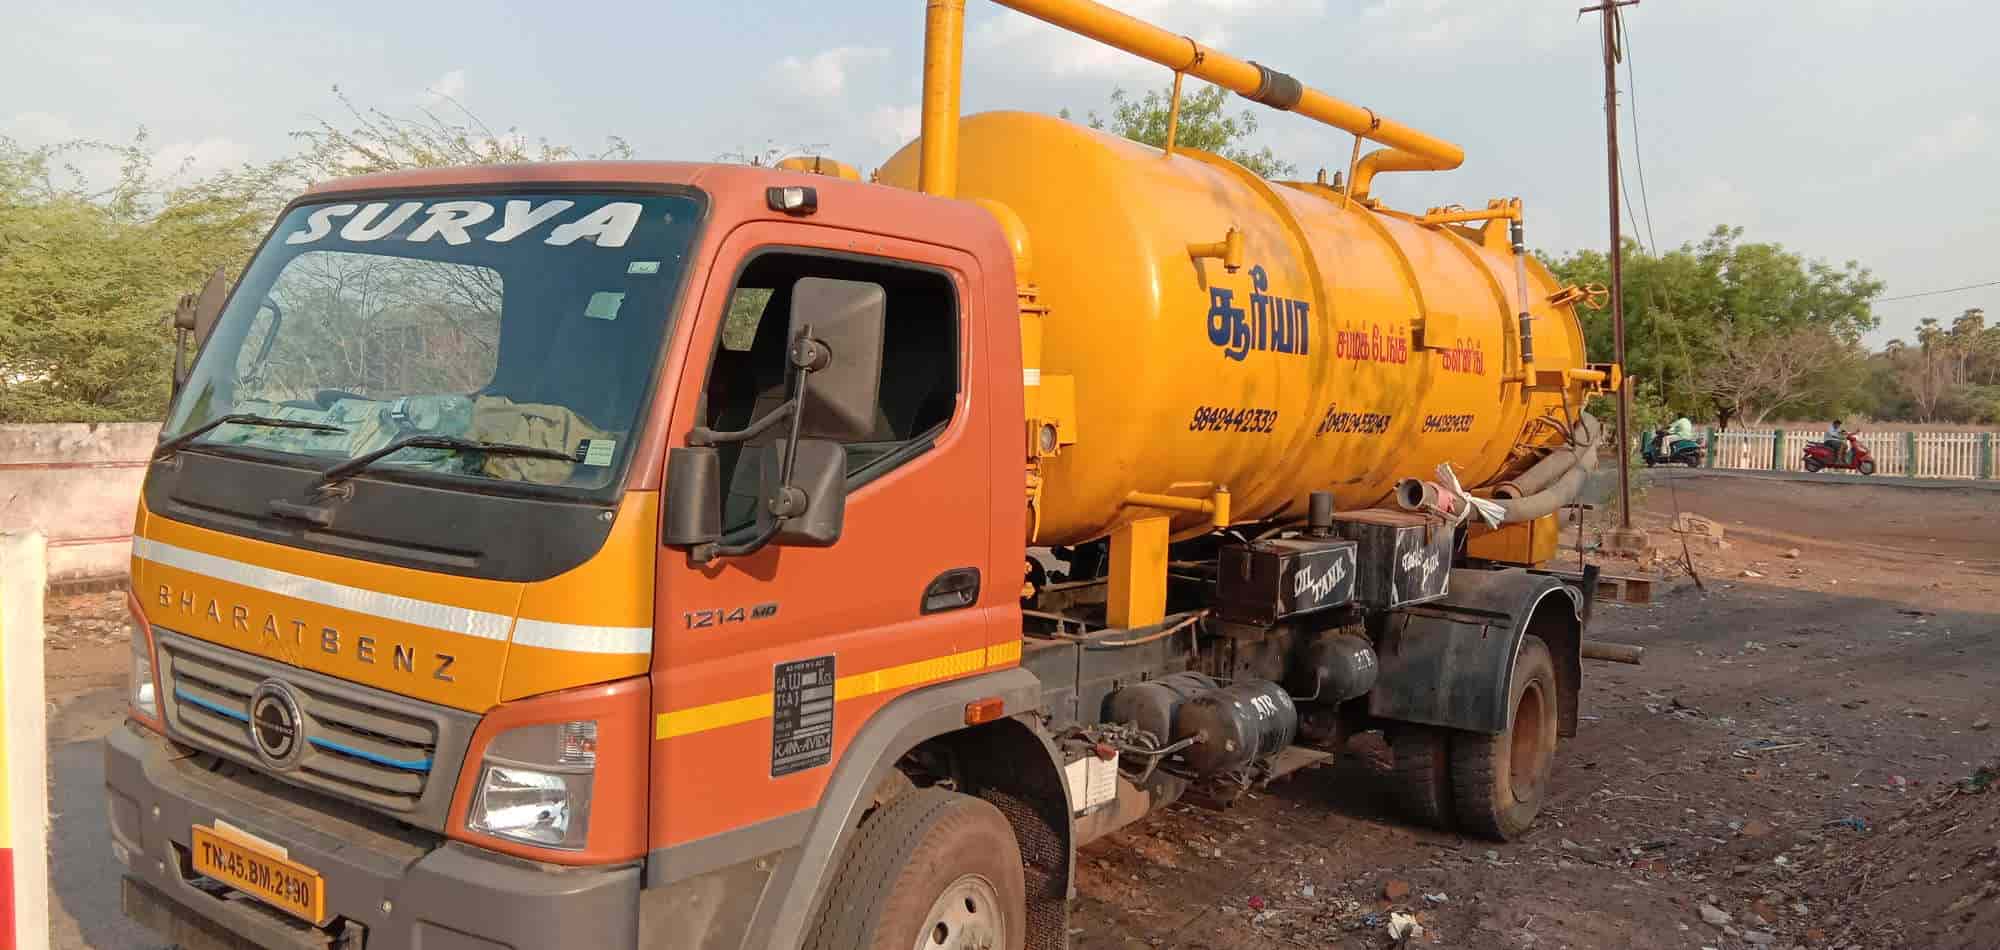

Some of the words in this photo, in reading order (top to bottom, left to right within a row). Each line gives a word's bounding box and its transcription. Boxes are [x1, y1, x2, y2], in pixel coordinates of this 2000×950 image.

[285, 200, 643, 247] SURYA
[1189, 405, 1278, 433] 9842442332
[1294, 564, 1314, 598] OIL
[1312, 556, 1347, 603] TANK
[159, 584, 456, 683] BHARATBENZ
[683, 607, 745, 630] 1214
